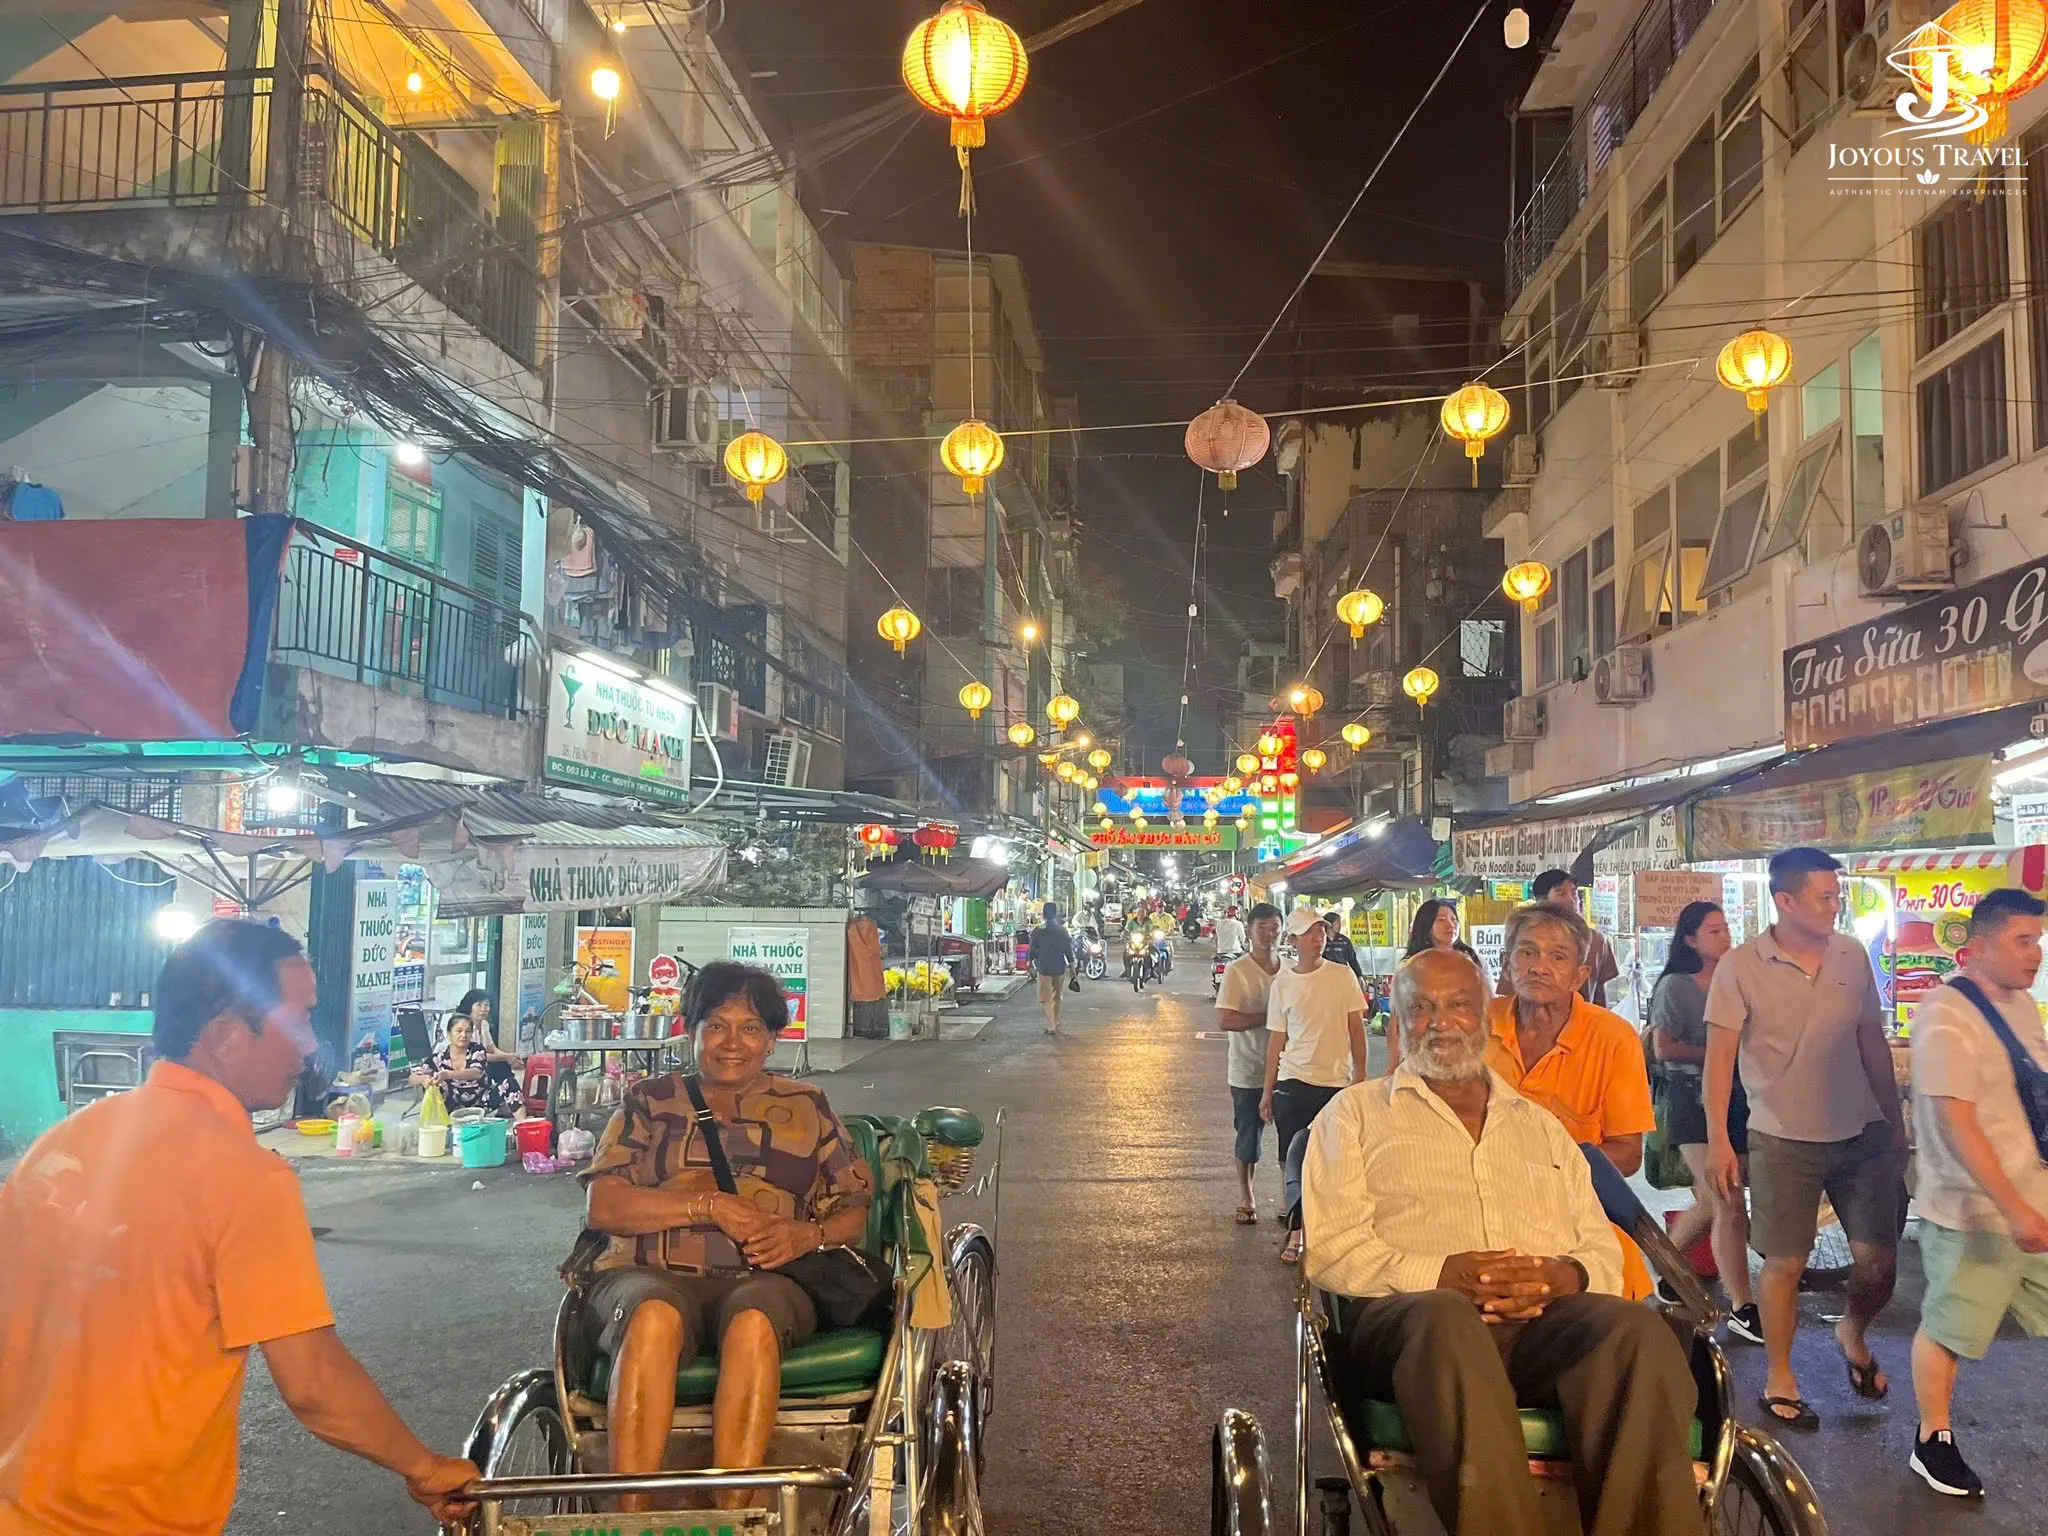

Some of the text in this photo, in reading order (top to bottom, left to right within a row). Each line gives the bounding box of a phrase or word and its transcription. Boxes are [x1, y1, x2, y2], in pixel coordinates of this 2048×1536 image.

[1790, 643, 1847, 696] Trà
[1854, 624, 1925, 678] Sữa
[1934, 596, 1989, 654] 30
[587, 707, 629, 745] ĐỨC
[1517, 827, 1546, 861] Giang
[1473, 860, 1488, 873] Fish
[1489, 860, 1514, 873] Noodle
[1516, 859, 1537, 874] Soup
[529, 853, 680, 902] NHÀ THUỐC ĐỨC MẠNH
[367, 887, 387, 908] NHÀ
[1928, 883, 1949, 909] 30
[359, 912, 393, 937] THUỐC
[525, 934, 543, 950] ĐỨC
[1476, 927, 1501, 945] Bún
[362, 943, 387, 963] ĐỨC
[732, 940, 804, 958] NHÀ THUỐC
[355, 970, 391, 991] MẠNH
